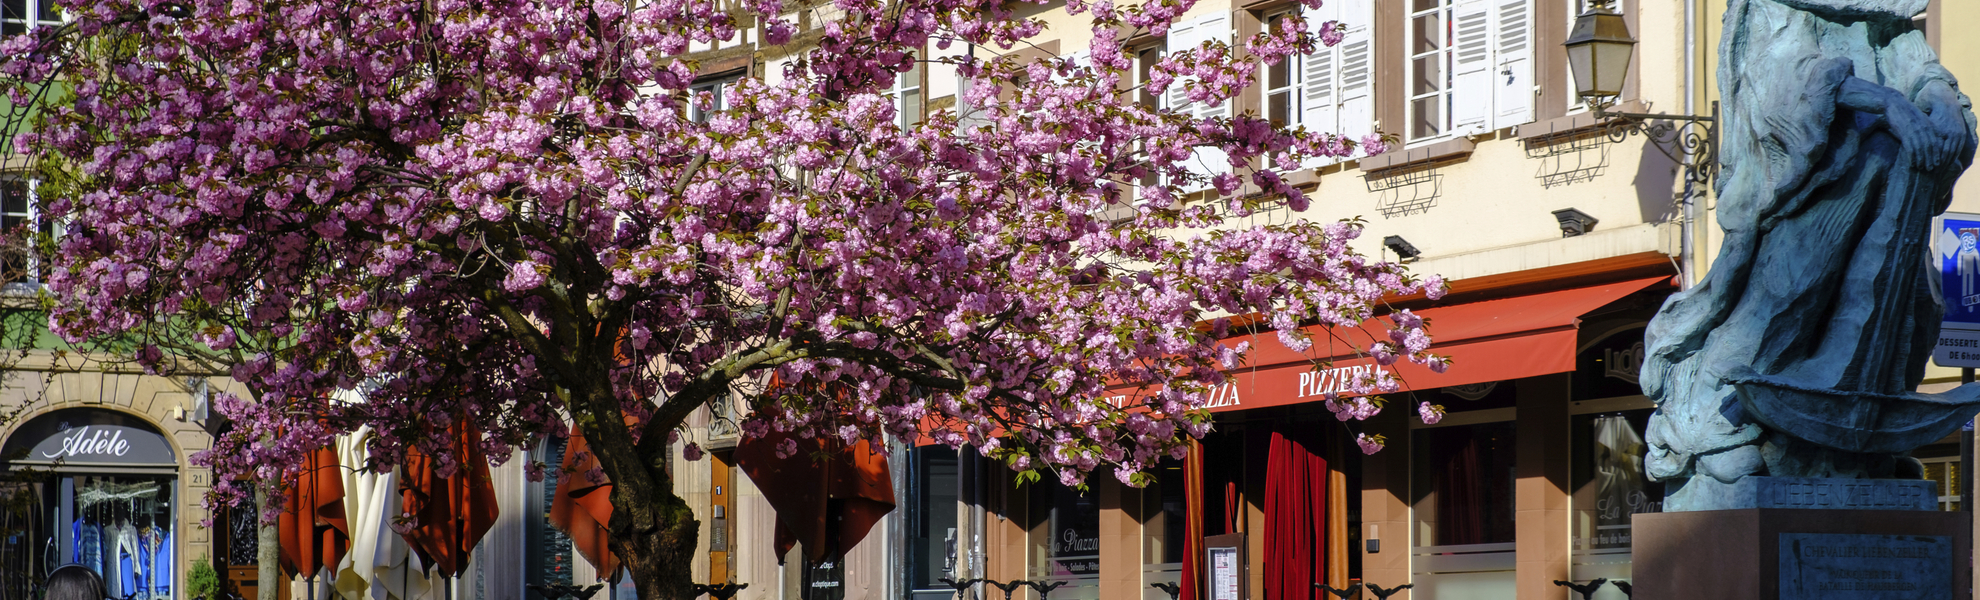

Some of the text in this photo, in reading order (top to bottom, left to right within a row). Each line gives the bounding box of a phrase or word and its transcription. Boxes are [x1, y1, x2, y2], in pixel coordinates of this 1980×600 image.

[1939, 337, 1979, 348] DESSERTE
[1949, 351, 1960, 360] DE
[41, 425, 130, 458] Adèle
[192, 474, 202, 483] 21
[716, 486, 721, 495] 1
[1772, 483, 1922, 507] LIEBENZELLER
[1597, 495, 1620, 519] La
[1063, 528, 1099, 553] Piazza
[1600, 533, 1609, 544] feu
[1610, 533, 1618, 543] de
[1804, 545, 1931, 559] CHEVALIER LIEBENZELLER
